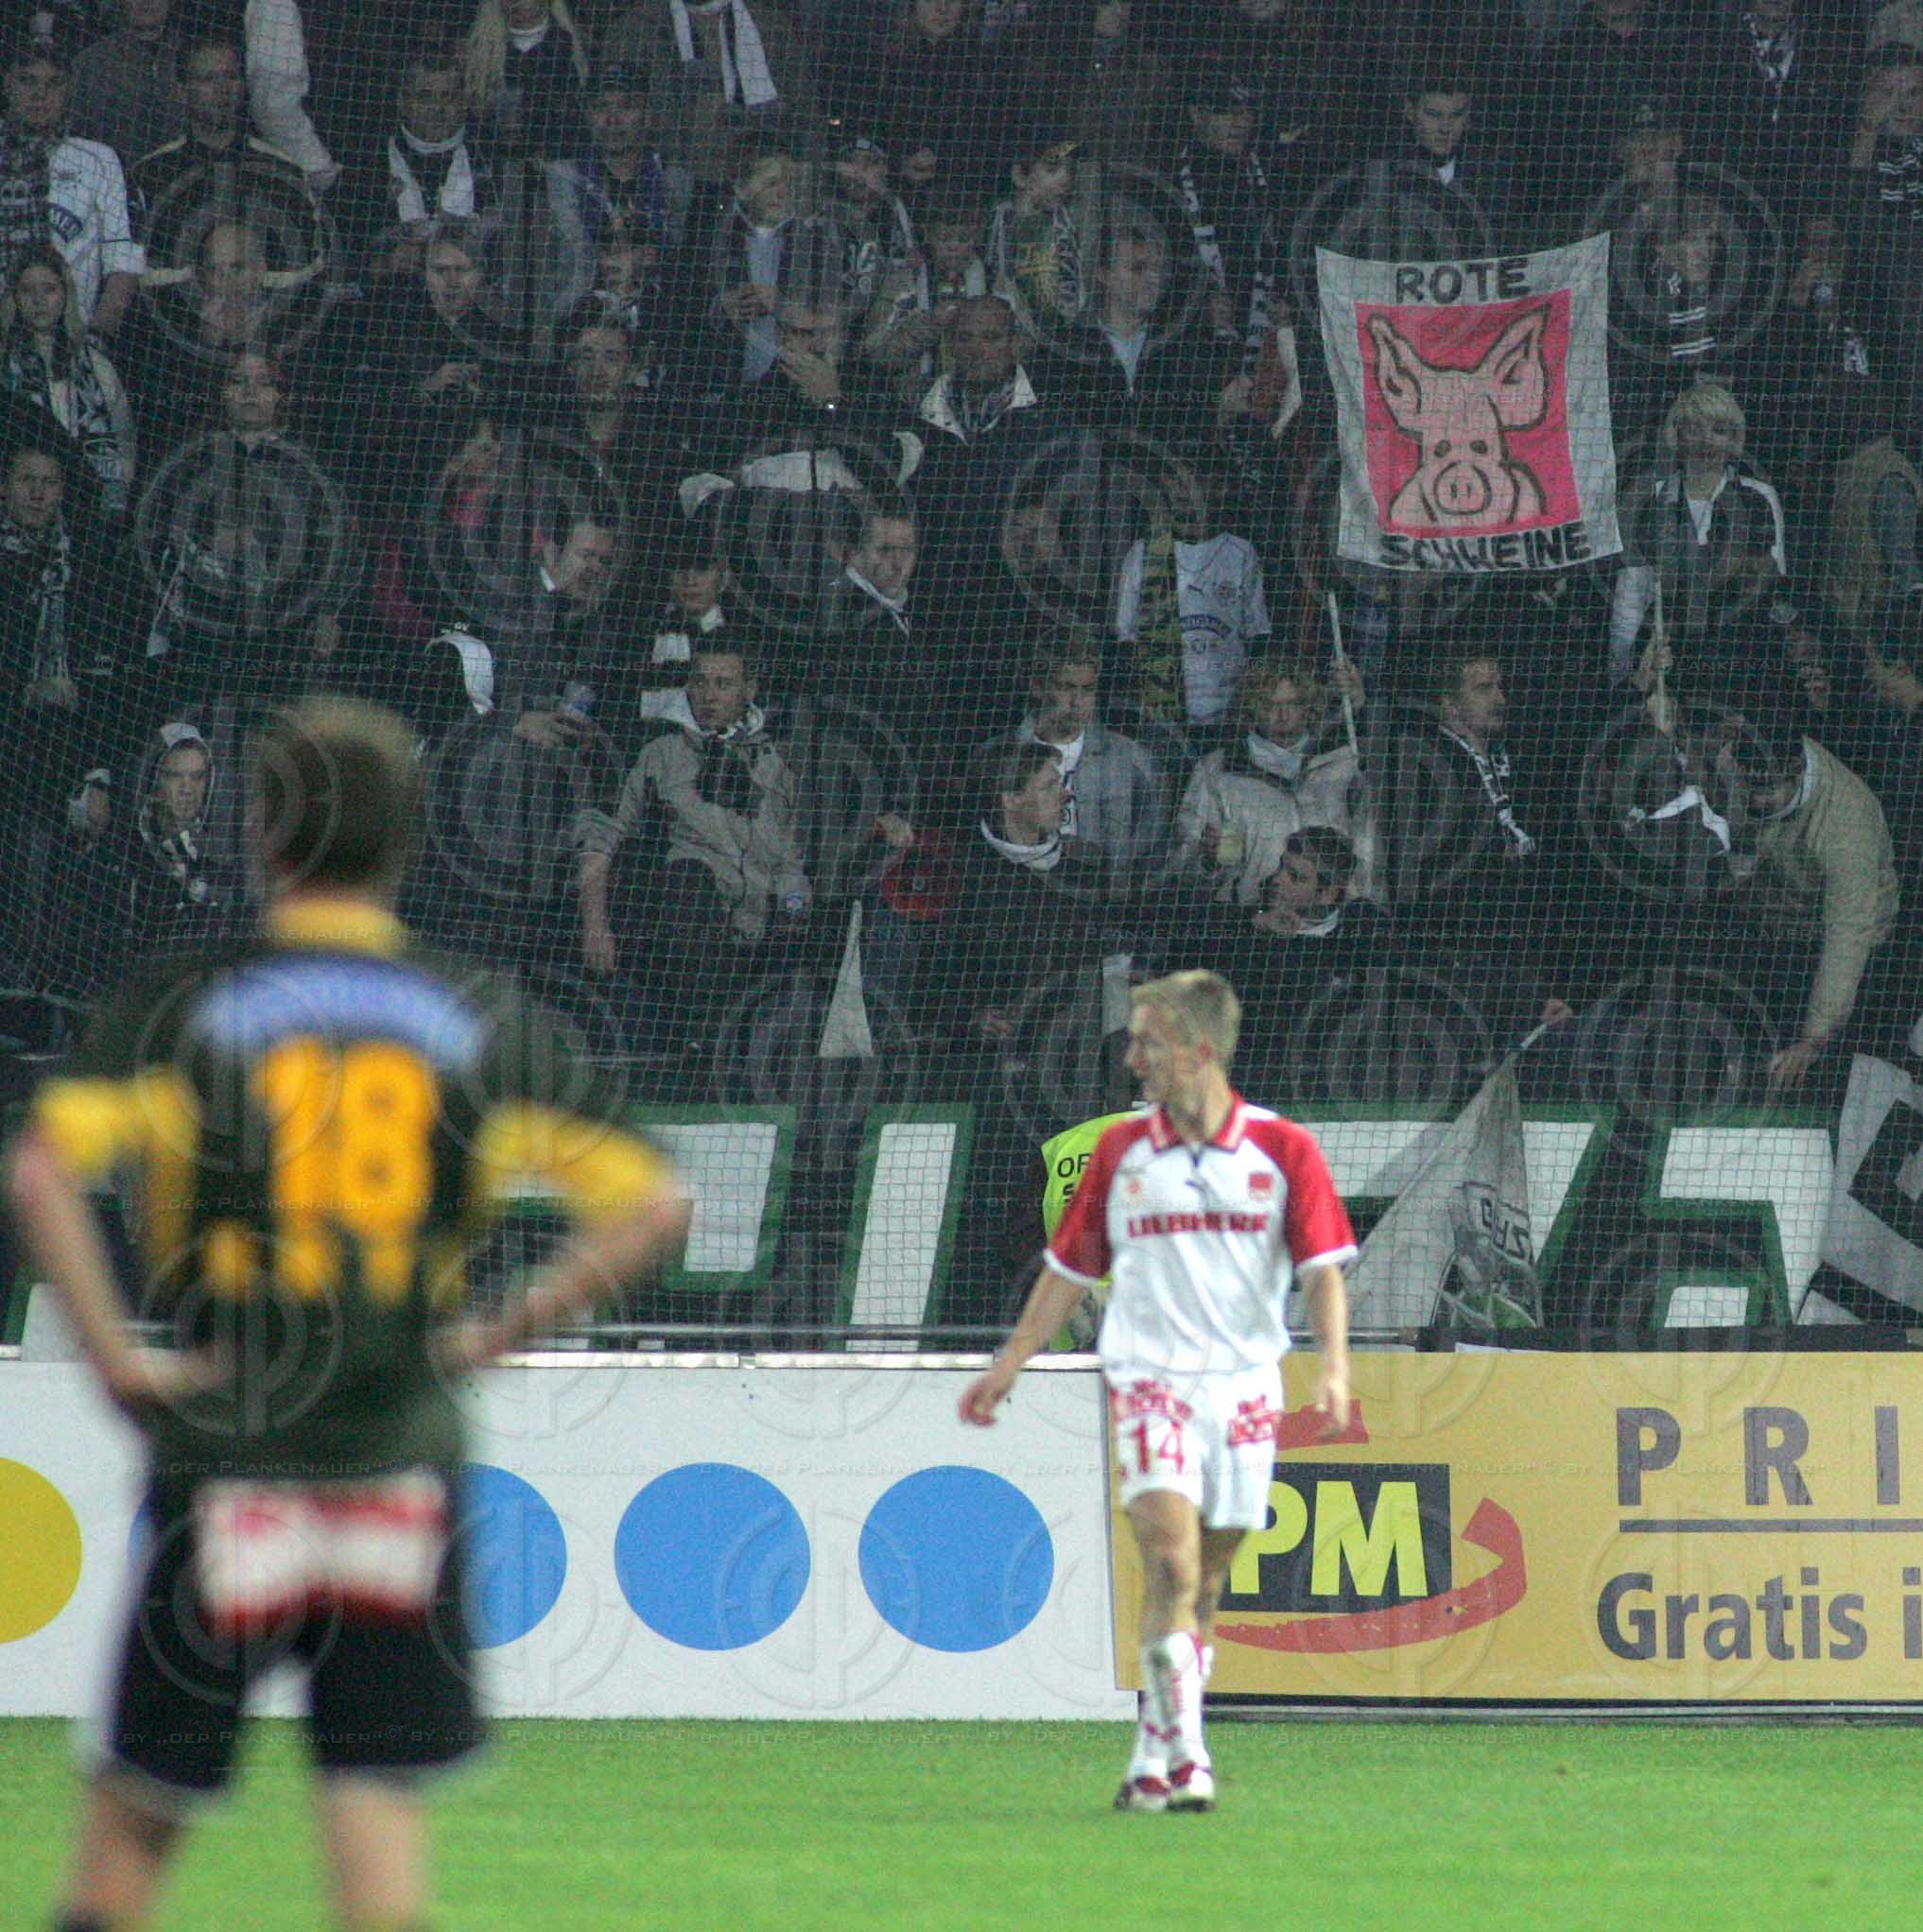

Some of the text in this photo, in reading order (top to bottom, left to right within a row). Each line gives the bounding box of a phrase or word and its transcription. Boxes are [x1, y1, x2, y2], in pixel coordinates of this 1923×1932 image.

[1396, 256, 1530, 304] ROTE
[1131, 1419, 1186, 1475] 14
[1596, 1565, 1868, 1662] Gratis
